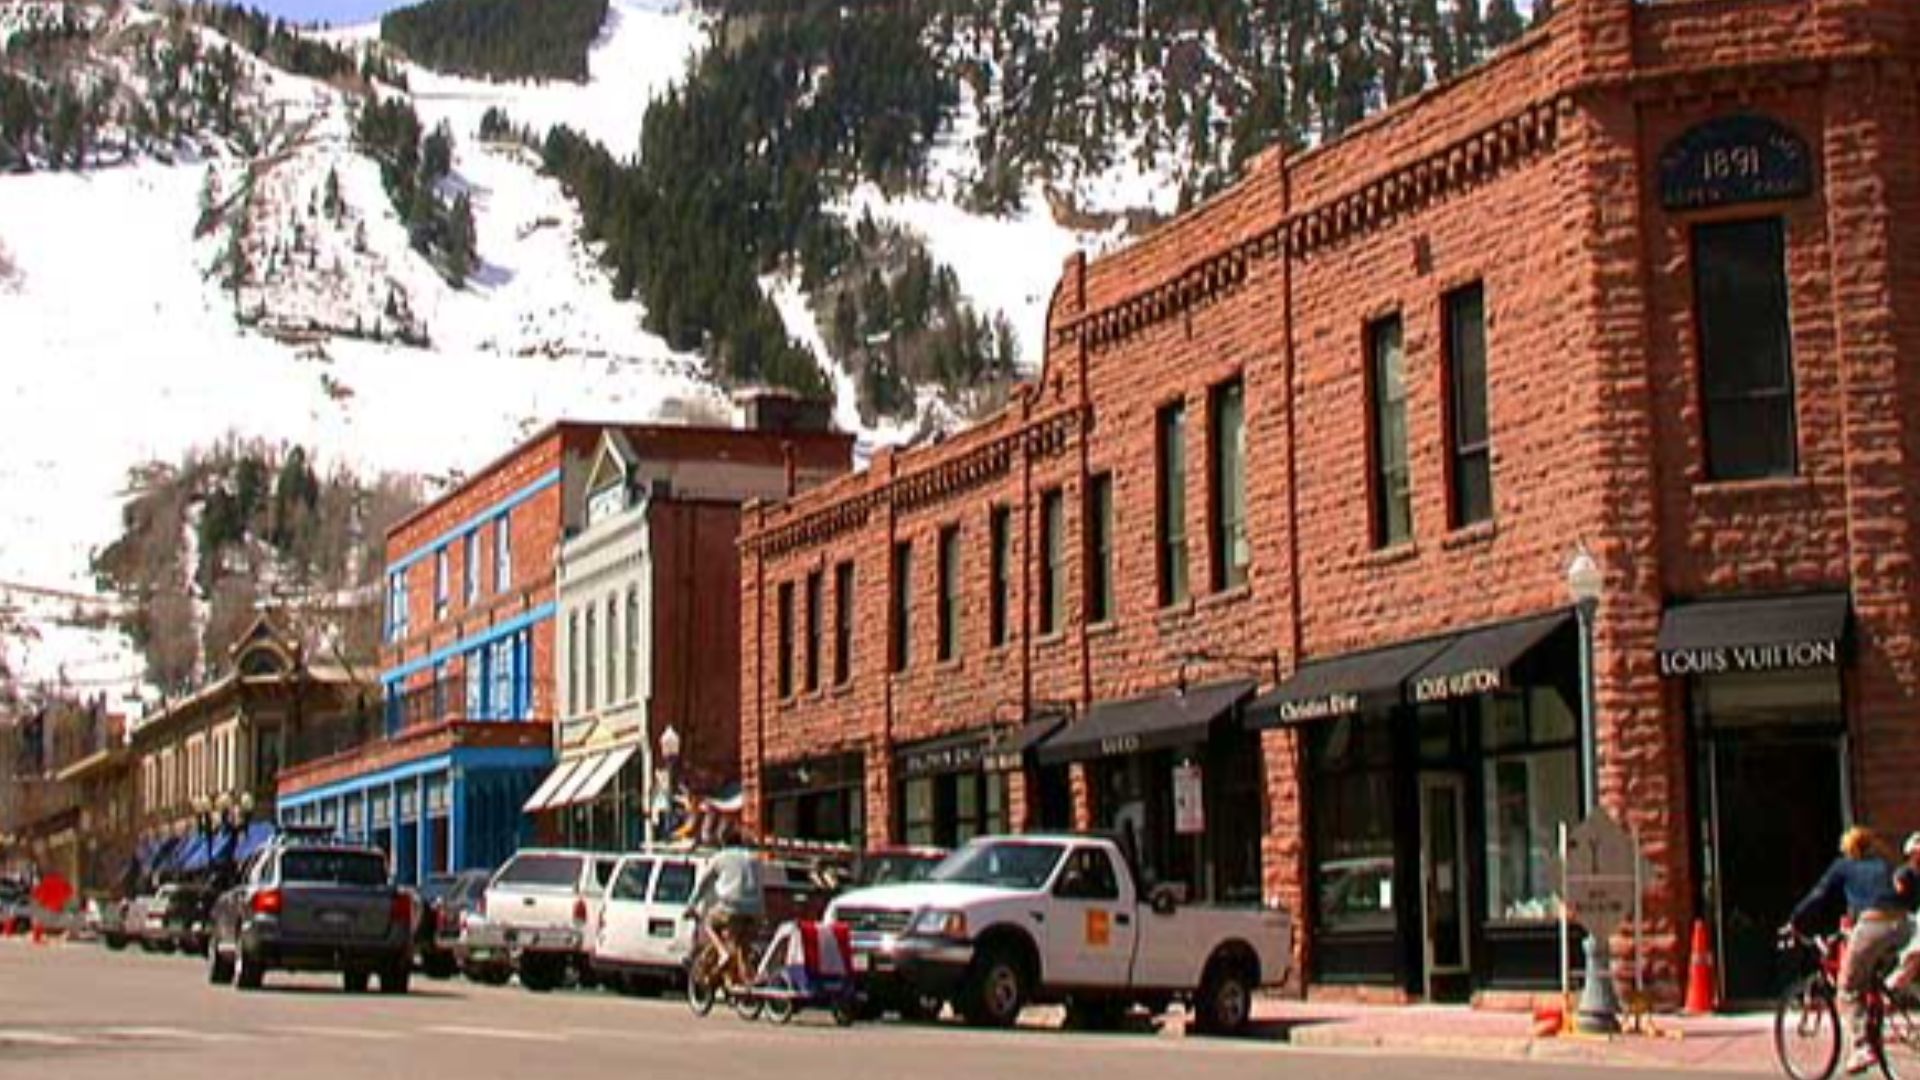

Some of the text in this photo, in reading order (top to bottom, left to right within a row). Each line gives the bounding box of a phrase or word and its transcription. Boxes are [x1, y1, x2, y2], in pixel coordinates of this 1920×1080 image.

[1704, 145, 1760, 181] 1891
[1661, 639, 1836, 675] LOUIS VUITTON
